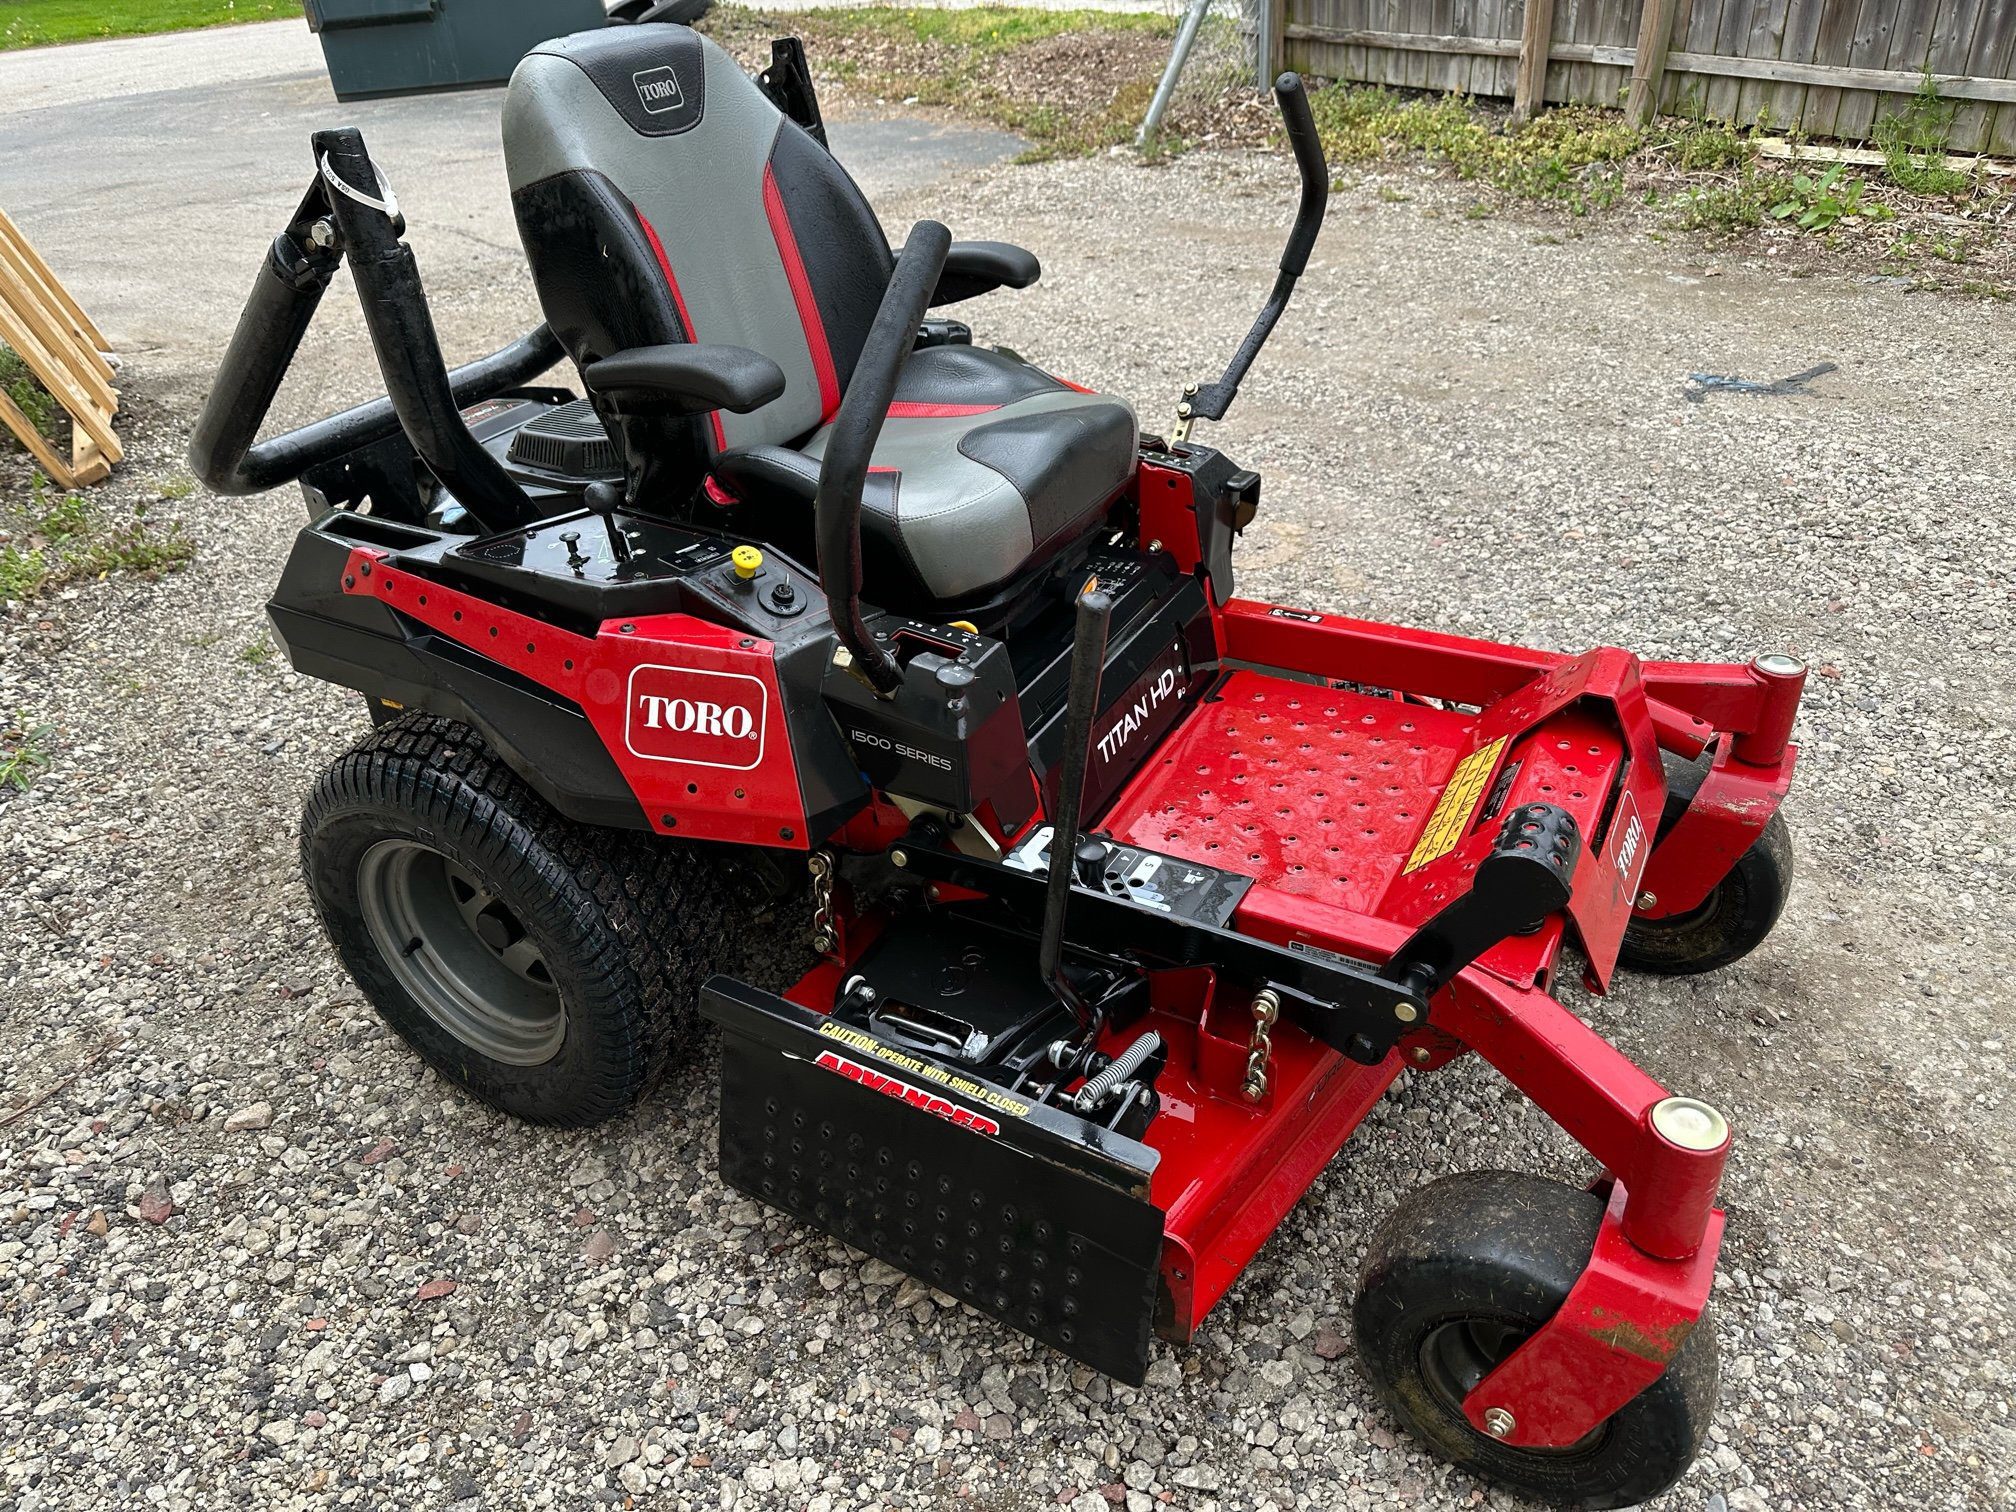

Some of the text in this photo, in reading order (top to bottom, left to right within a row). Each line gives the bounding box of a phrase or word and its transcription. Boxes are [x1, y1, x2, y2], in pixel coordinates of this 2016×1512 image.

[640, 80, 676, 100] TORO
[640, 695, 753, 738] TORO
[1097, 669, 1174, 763] TITAN HD
[851, 730, 952, 771] 1500 SERIES
[1618, 816, 1639, 880] TORO
[819, 1022, 1030, 1117] CAUTION: OPERATE WITH SHIELD CLOSED
